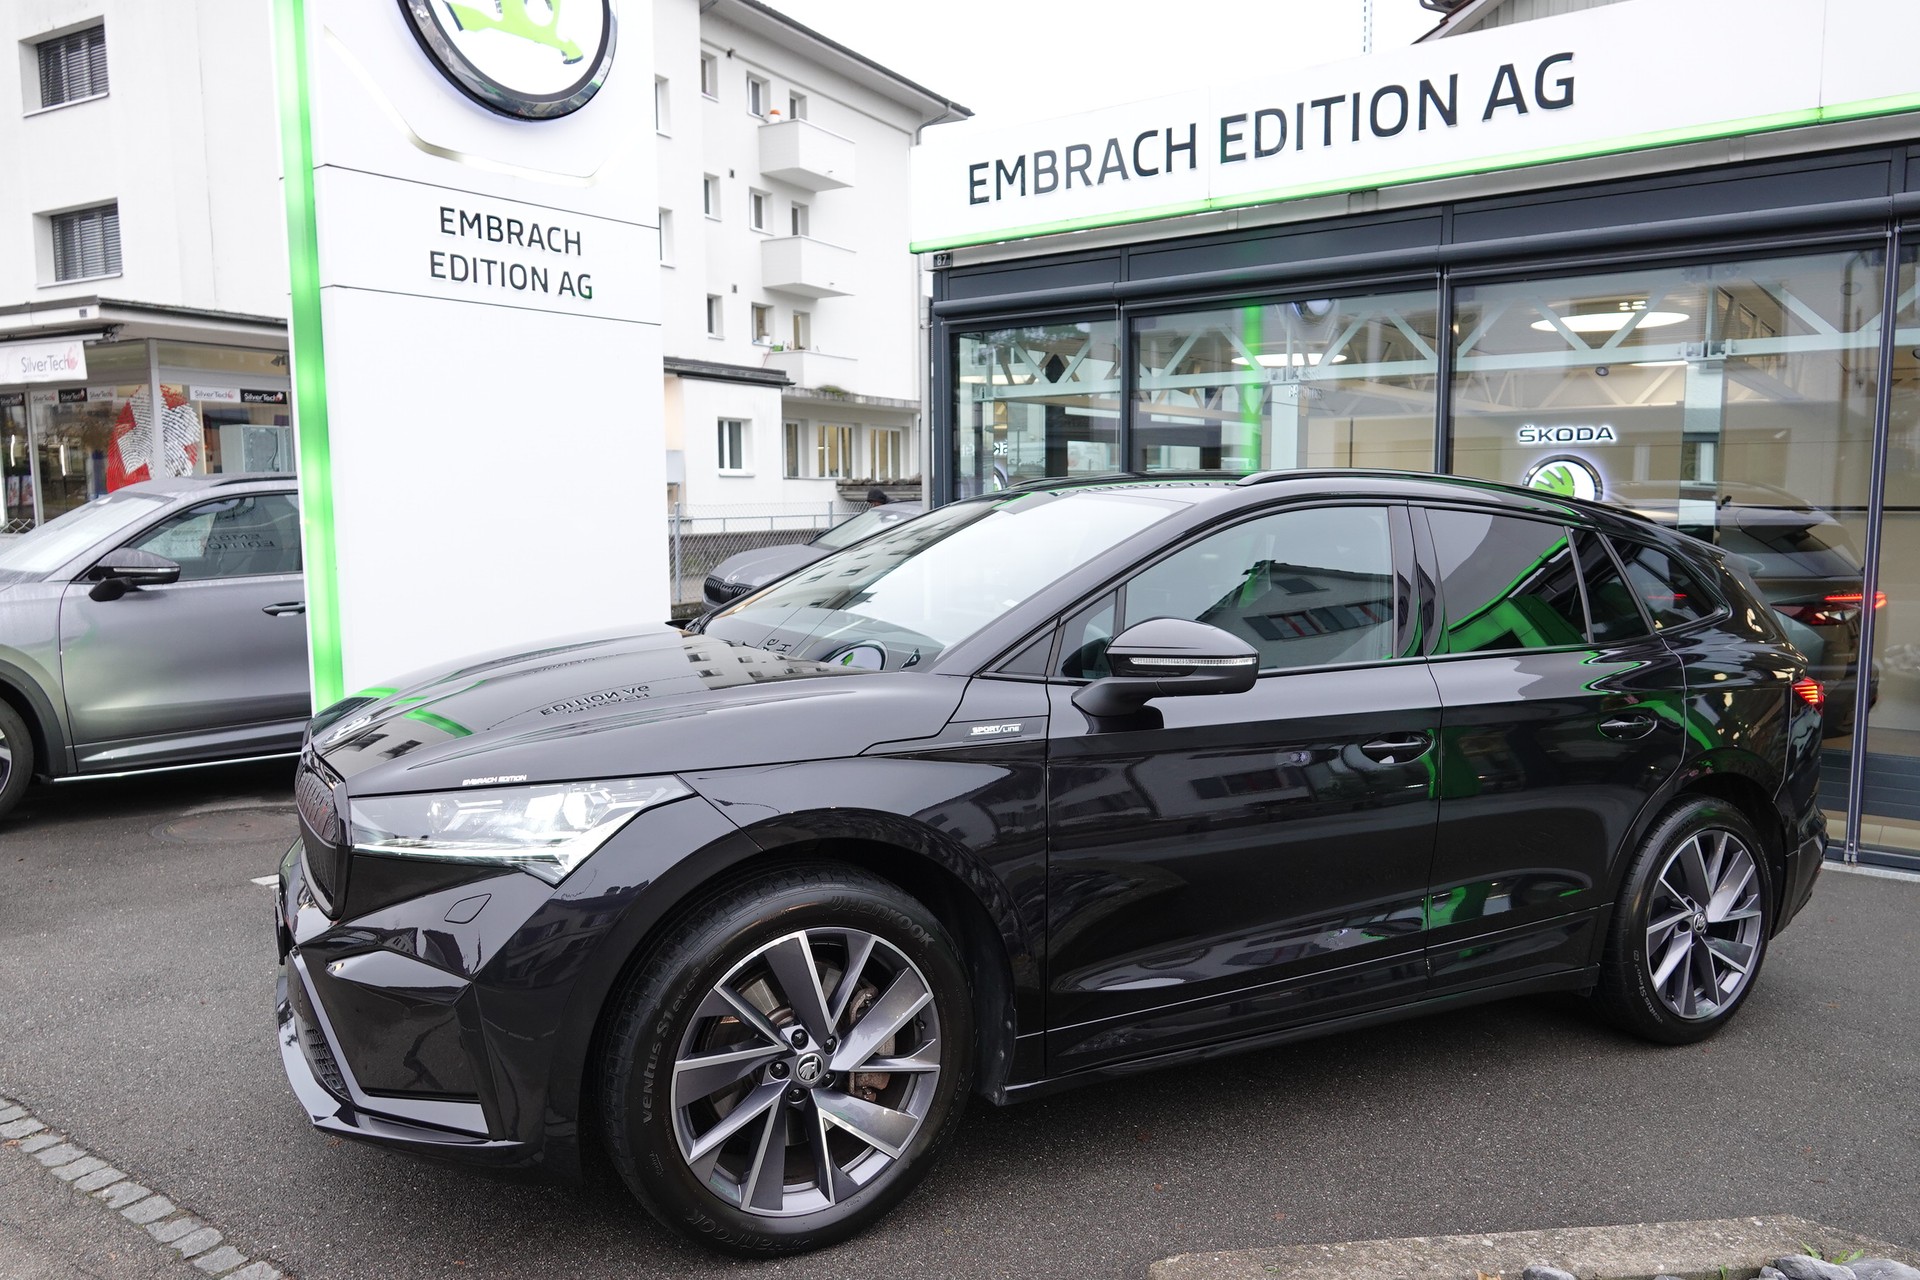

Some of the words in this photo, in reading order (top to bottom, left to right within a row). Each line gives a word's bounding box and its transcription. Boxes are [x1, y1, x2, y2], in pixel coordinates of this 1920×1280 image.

[969, 123, 1197, 206] EMBRACH
[1220, 73, 1459, 165] EDITION
[1481, 52, 1575, 122] AG
[440, 206, 582, 257] EMBRACH
[430, 250, 549, 293] EDITION
[558, 271, 593, 300] AG
[936, 254, 948, 266] 87
[1519, 425, 1614, 443] ŠKODA
